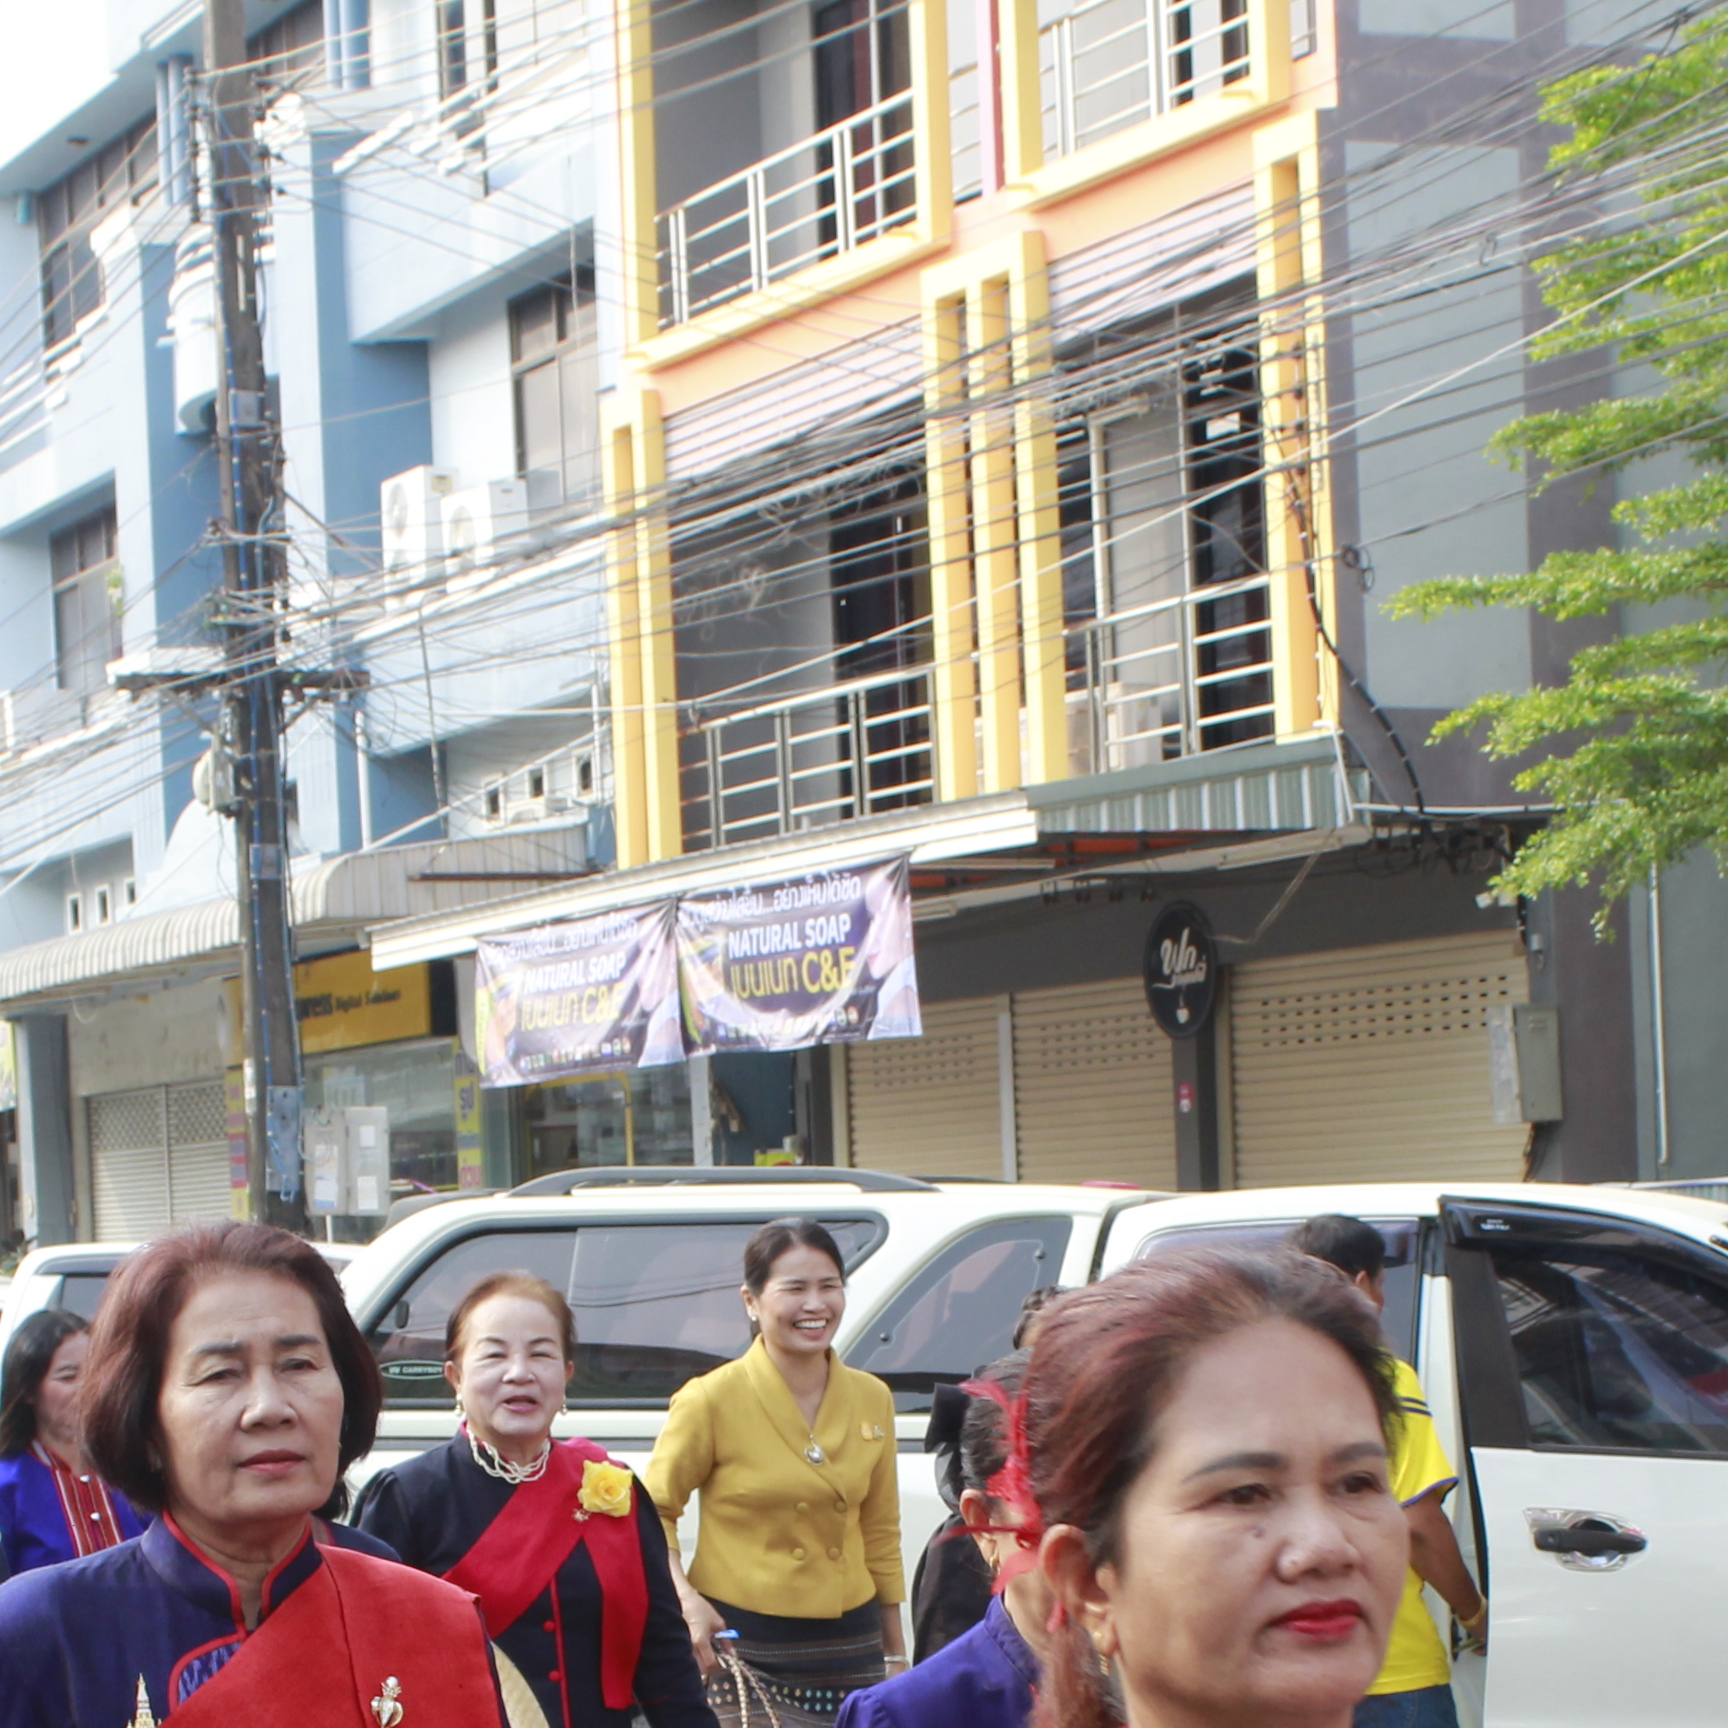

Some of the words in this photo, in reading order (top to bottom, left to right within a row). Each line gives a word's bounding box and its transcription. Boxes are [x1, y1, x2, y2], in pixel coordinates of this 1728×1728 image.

[728, 922, 802, 959] NATURAL
[805, 912, 852, 948] SOAP
[524, 956, 586, 994] NATURAL
[587, 950, 627, 983] SOAP
[801, 946, 856, 994] C&E
[581, 982, 626, 1025] C&E
